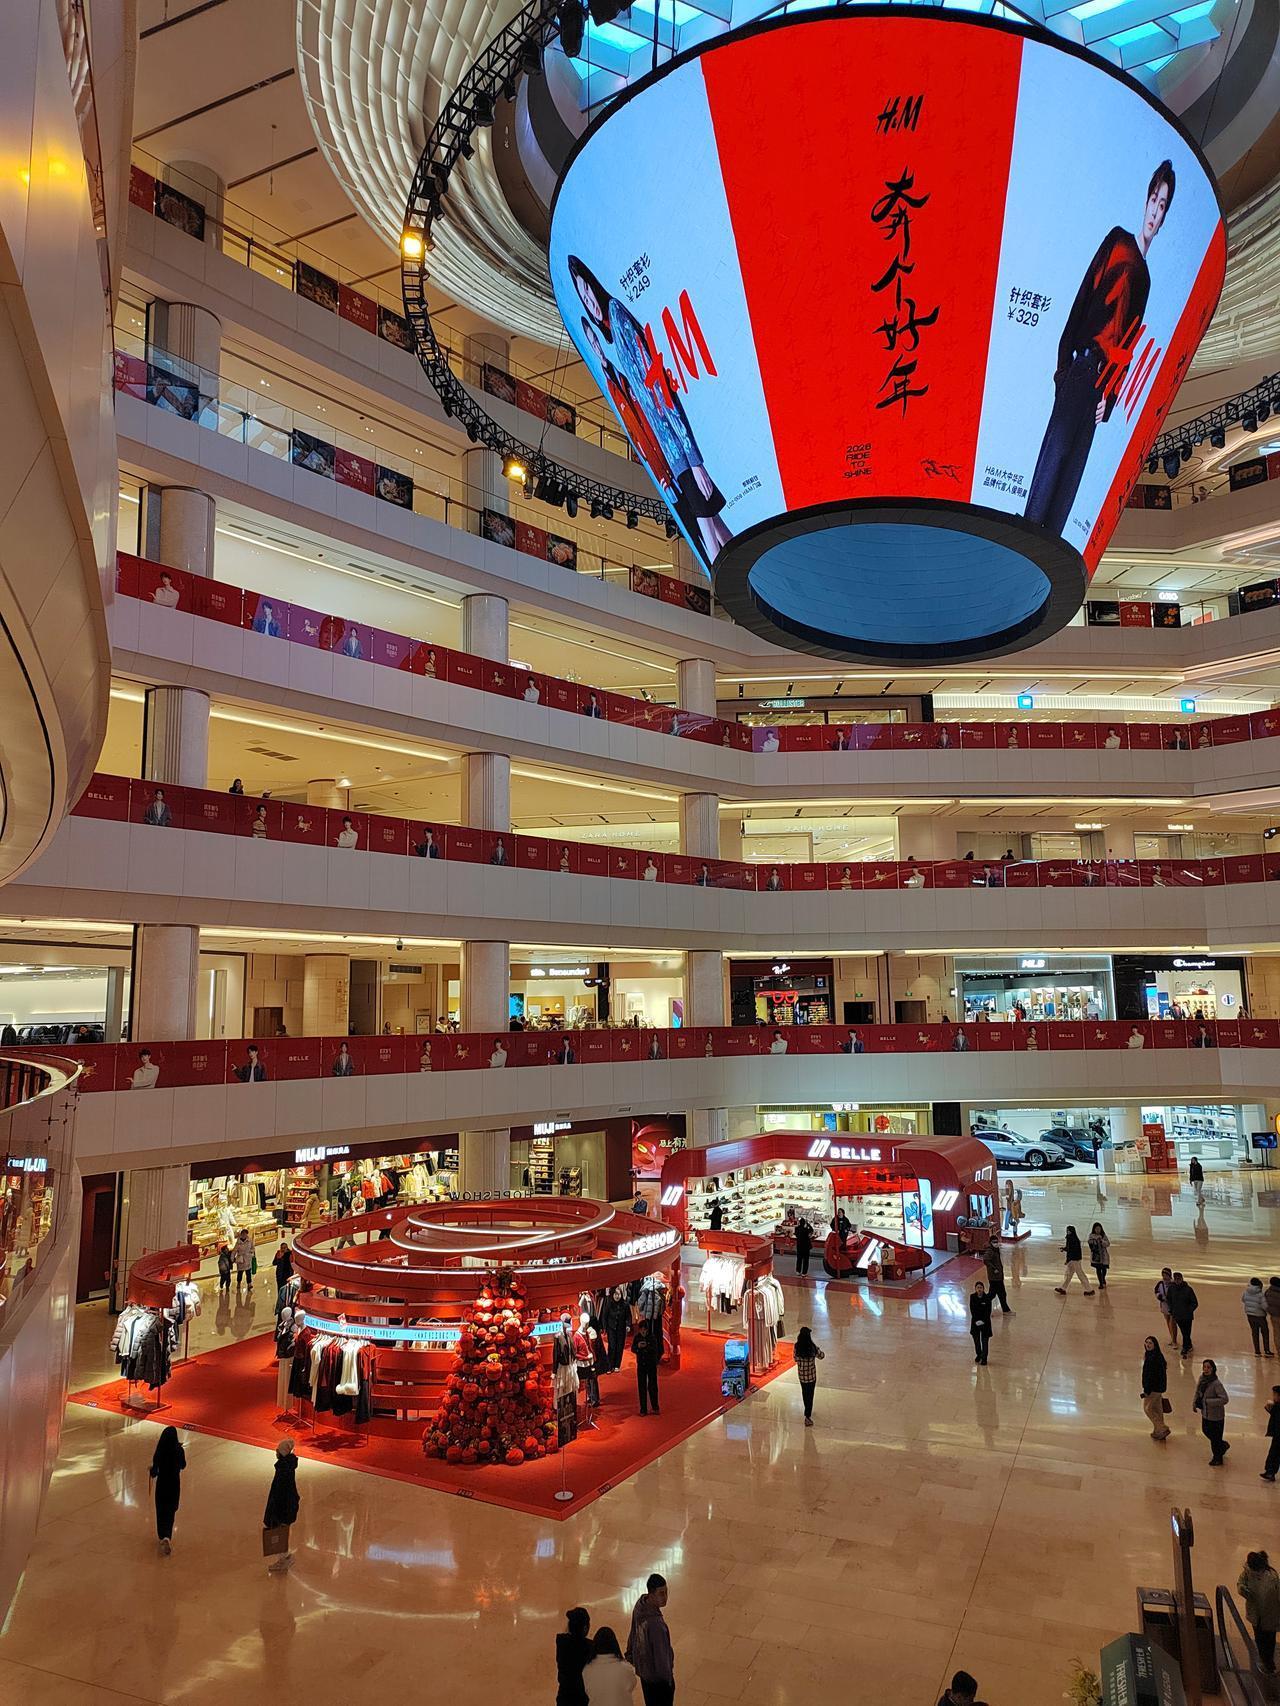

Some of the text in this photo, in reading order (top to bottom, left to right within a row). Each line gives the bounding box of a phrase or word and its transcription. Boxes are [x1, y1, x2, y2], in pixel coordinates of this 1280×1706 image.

[876, 94, 925, 135] H&M
[619, 252, 651, 290] 针织套衫
[626, 274, 651, 303] ¥249
[1009, 286, 1052, 312] 针织套衫
[1007, 305, 1040, 327] ¥329
[636, 289, 718, 417] H&M
[1094, 315, 1162, 424] H&M
[87, 792, 114, 801] BELLE
[1172, 958, 1216, 969] Champion
[533, 1122, 555, 1136] MUJI
[295, 1146, 326, 1163] MUJI
[830, 1146, 882, 1161] BELLE
[617, 1229, 677, 1260] HOPESHOW
